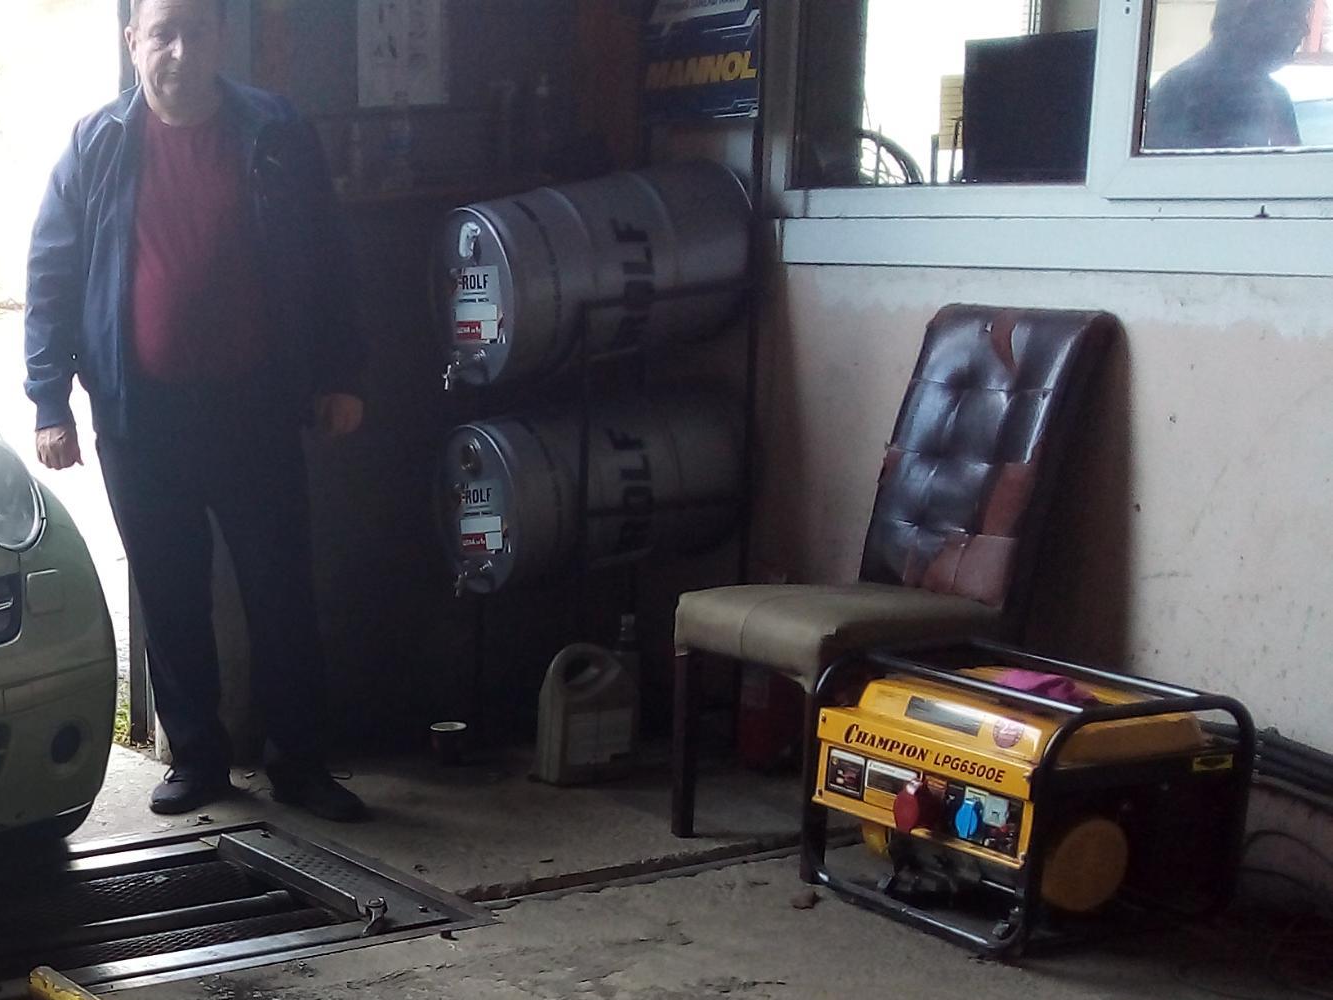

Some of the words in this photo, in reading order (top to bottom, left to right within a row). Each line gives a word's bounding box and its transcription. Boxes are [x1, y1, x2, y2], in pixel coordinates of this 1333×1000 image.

[646, 50, 758, 90] MANNOL
[462, 274, 489, 291] ROLF
[465, 488, 492, 505] ROLF
[844, 723, 931, 762] CHAMPION
[933, 752, 1007, 784] LPG6500E
